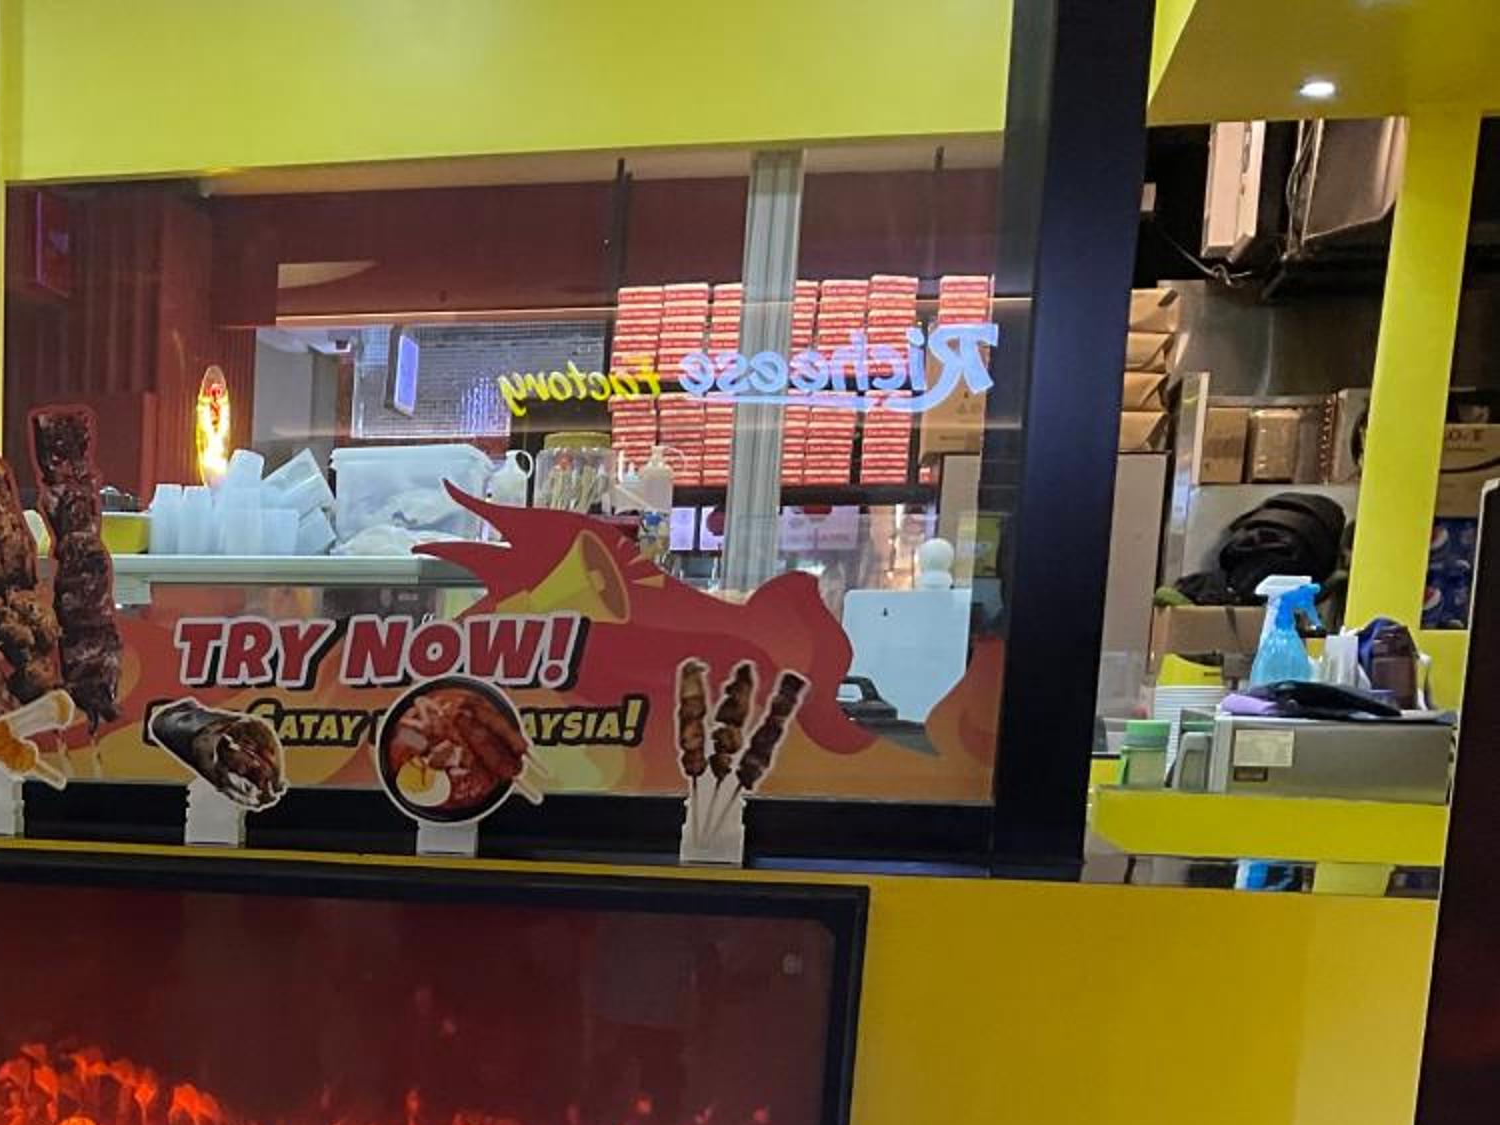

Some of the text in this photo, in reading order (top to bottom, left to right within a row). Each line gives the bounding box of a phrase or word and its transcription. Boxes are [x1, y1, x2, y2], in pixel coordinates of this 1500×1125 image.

[175, 614, 581, 690] TRY NOW!
[521, 699, 644, 741] AYSIA!
